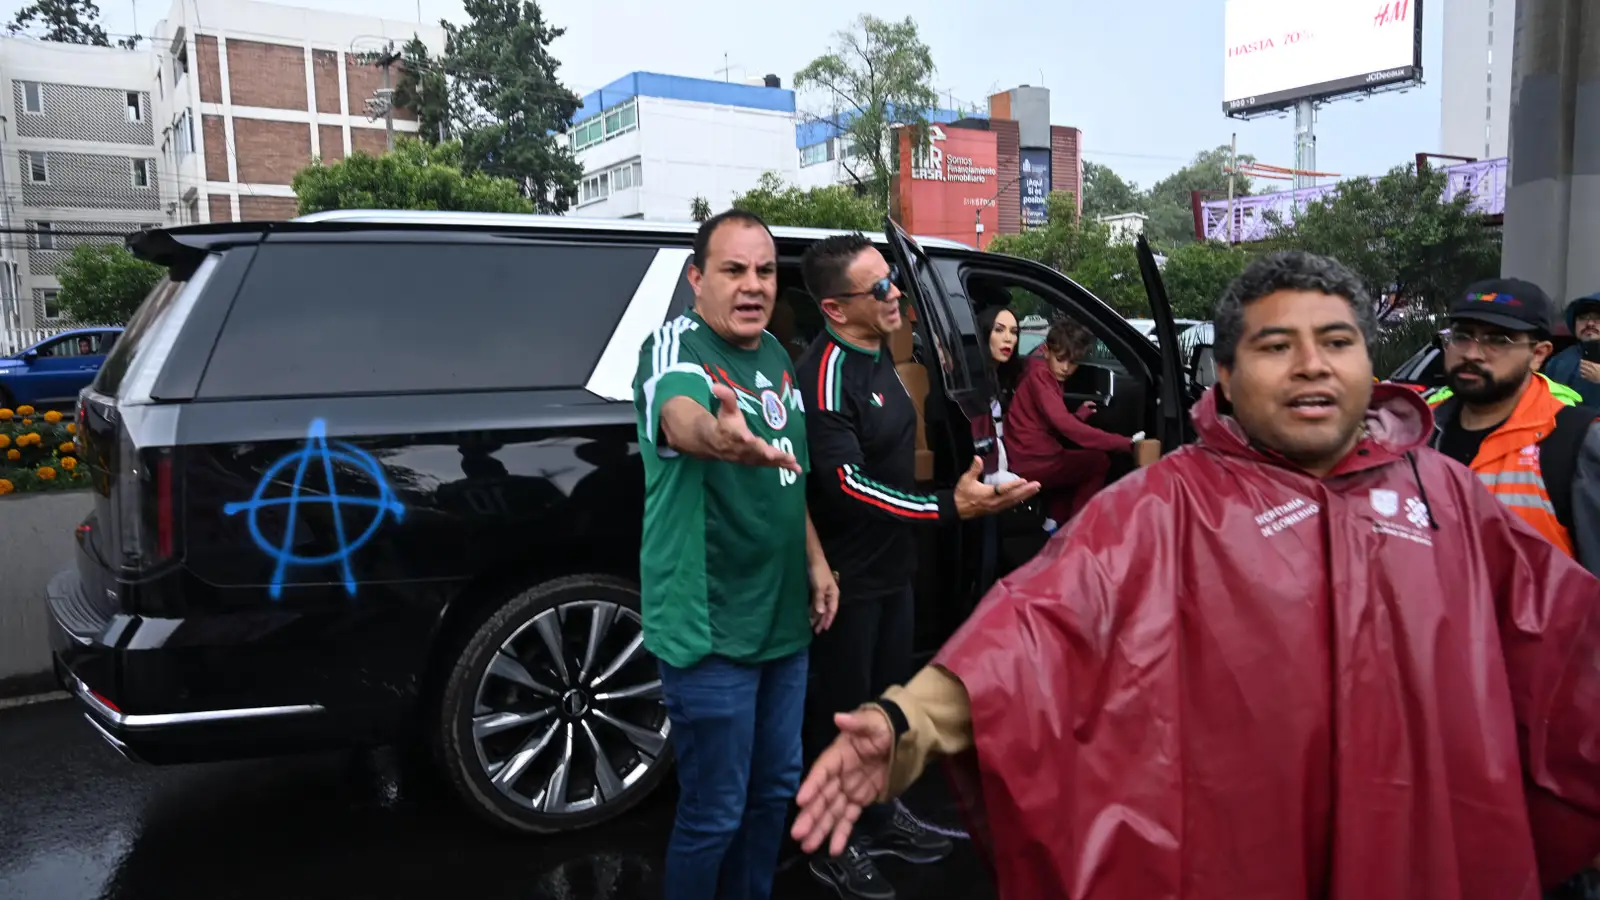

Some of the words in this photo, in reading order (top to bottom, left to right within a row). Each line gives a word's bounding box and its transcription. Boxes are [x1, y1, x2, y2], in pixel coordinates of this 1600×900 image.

[1228, 37, 1275, 58] HASTA
[1365, 68, 1405, 82] JCDecaux
[946, 154, 973, 166] Somos
[947, 164, 997, 176] Financiamiento
[947, 174, 986, 183] Inmobiliario
[772, 436, 797, 487] 10
[1260, 525, 1275, 538] DE
[1272, 503, 1320, 532] GOBIERNO
